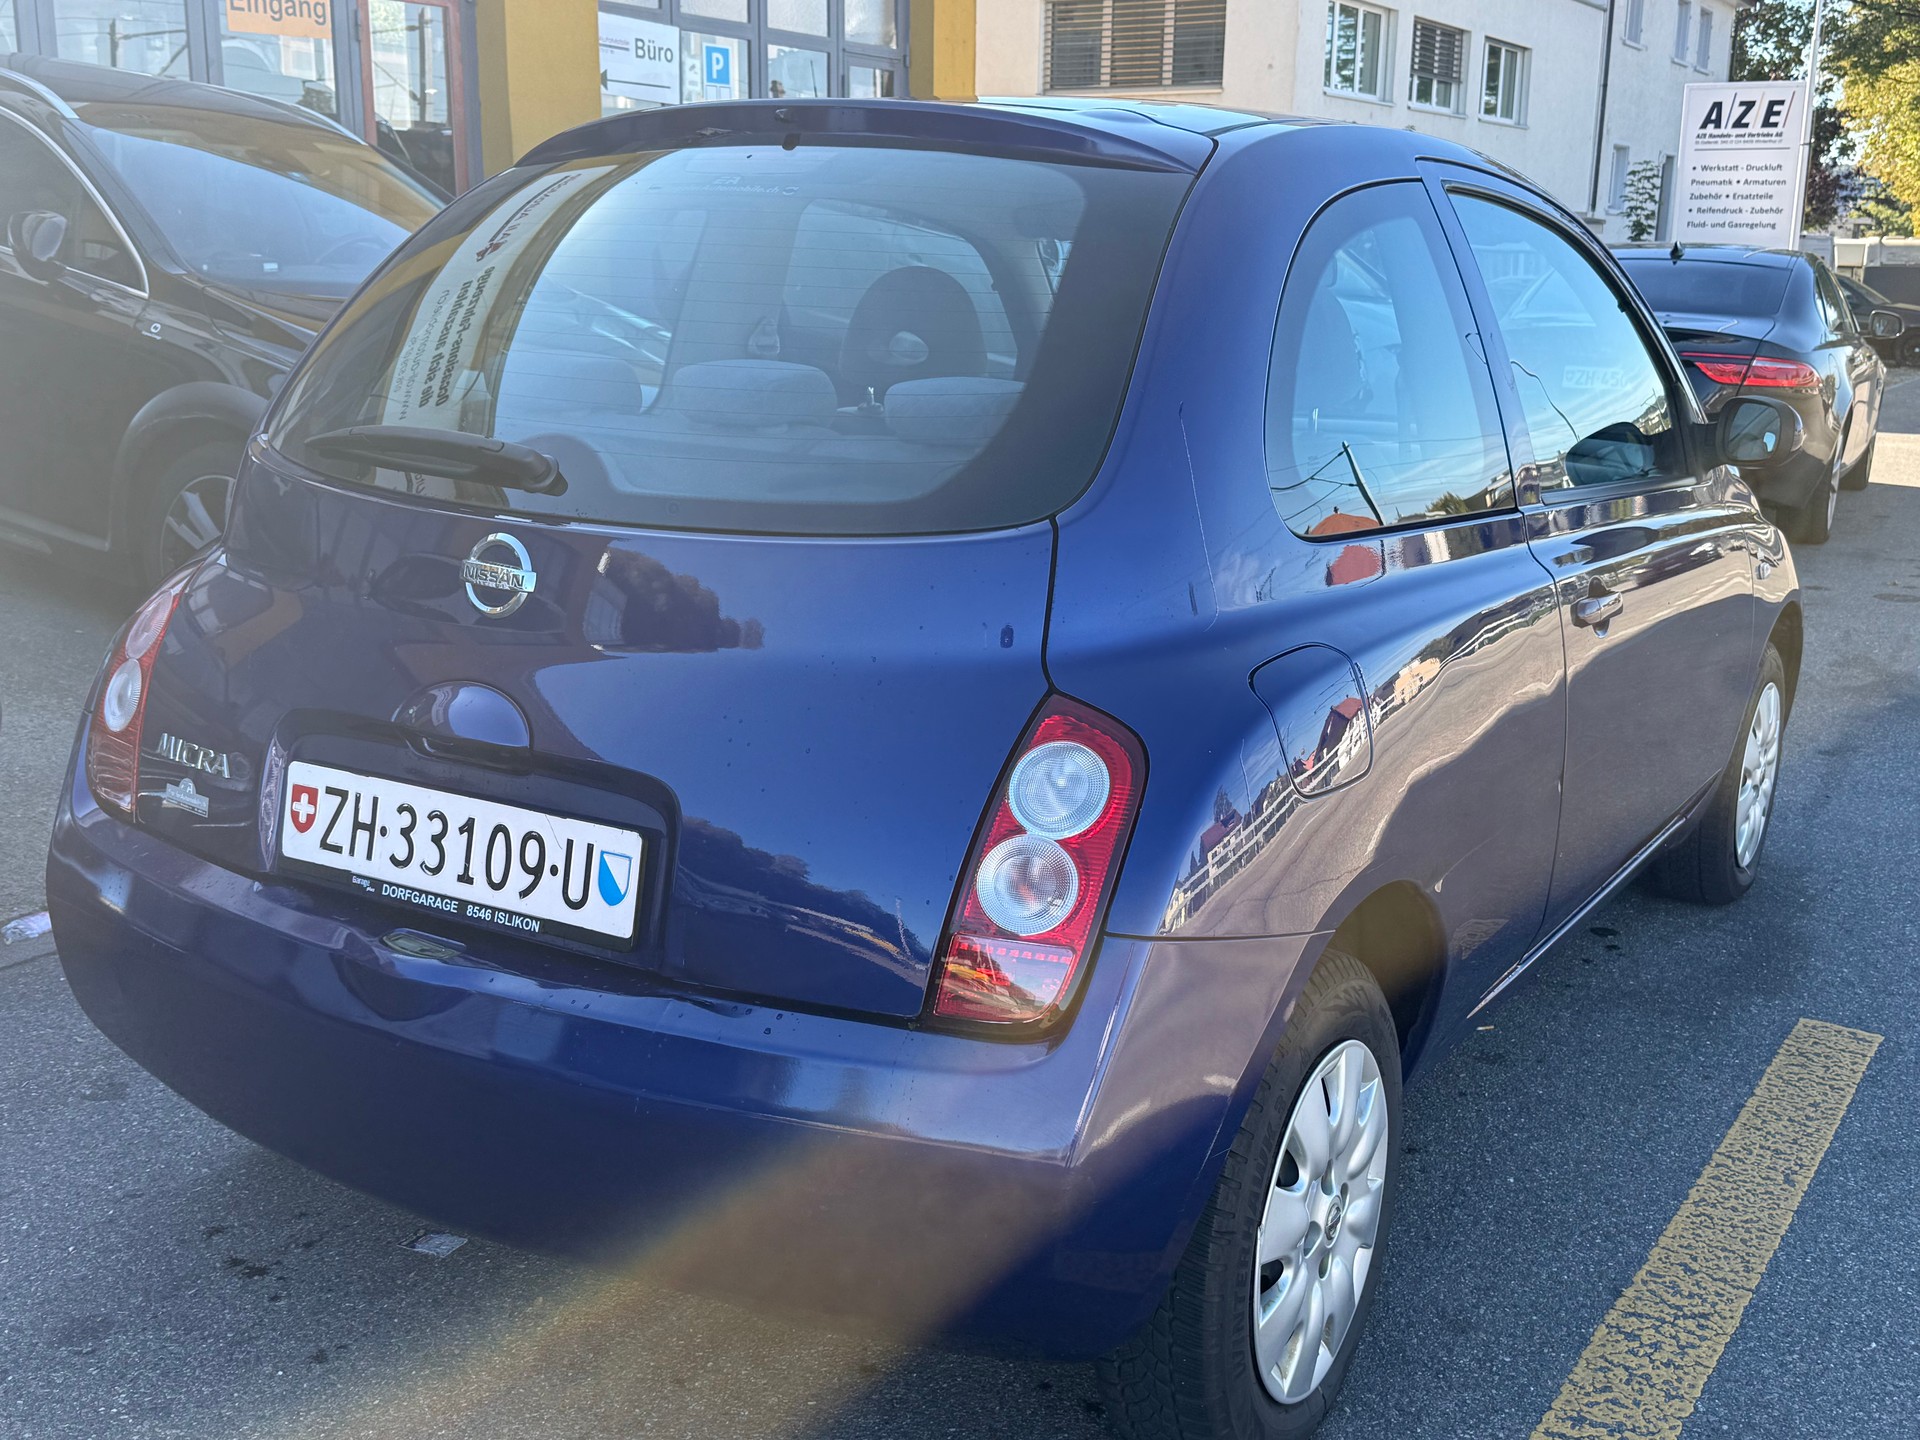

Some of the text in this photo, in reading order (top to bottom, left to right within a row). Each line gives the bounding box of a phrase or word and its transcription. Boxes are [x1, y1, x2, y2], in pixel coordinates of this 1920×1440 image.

[634, 37, 674, 63] Büro
[711, 52, 724, 80] P
[1700, 163, 1783, 172] Werkstatt Druckluft
[1690, 178, 1786, 186] Pneumatik Armaturen
[1689, 192, 1773, 200] Zubehör Ersatzteile
[1696, 206, 1784, 214] Reifendruck Zubehör
[1687, 220, 1776, 230] Fluid- und Gasregelung
[463, 563, 525, 590] NISSAN
[156, 732, 231, 779] MICRA
[381, 884, 540, 933] DORFGARAGE 8546 ISLIKON
